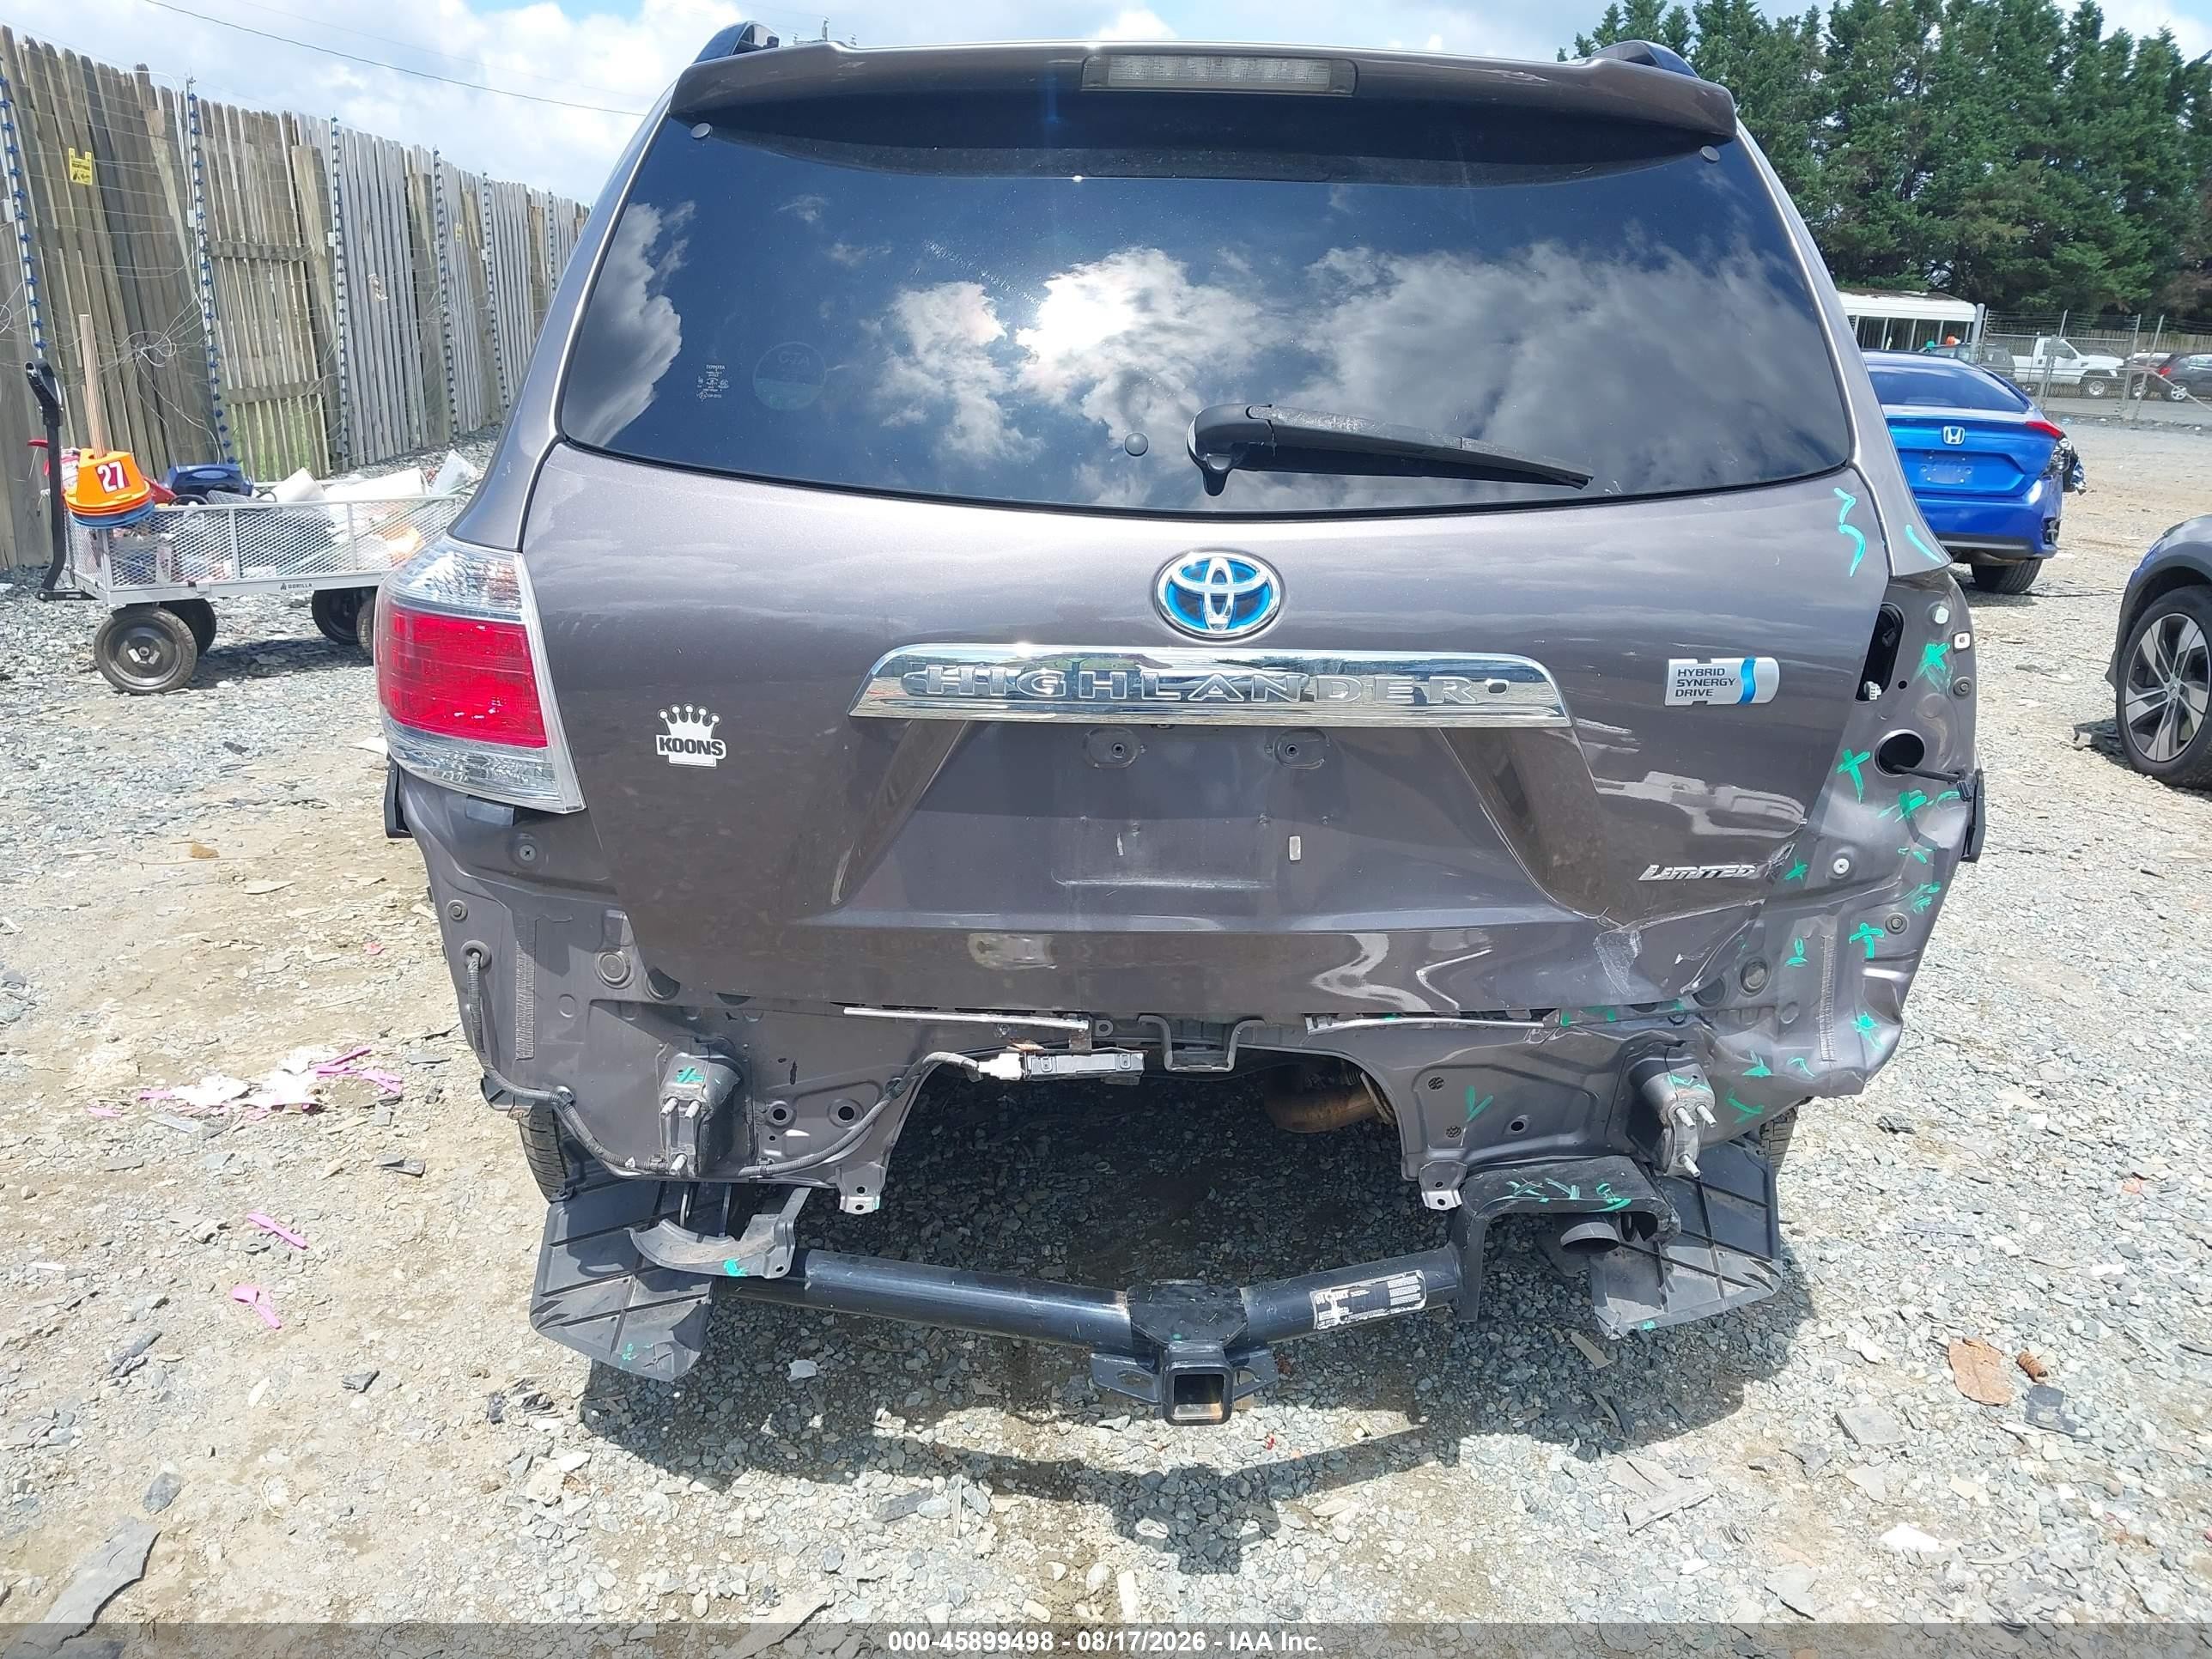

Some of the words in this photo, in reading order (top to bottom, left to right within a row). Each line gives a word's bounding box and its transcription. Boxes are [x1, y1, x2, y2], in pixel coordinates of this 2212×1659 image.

[97, 461, 125, 494] 27
[1678, 668, 1725, 677] HYBRID
[927, 665, 1477, 704] HIGHLANDER
[1677, 678, 1736, 687] SYNERGY
[1675, 689, 1714, 697] DRIVE
[659, 737, 724, 757] KOONS
[1638, 865, 1757, 881] LIMITED
